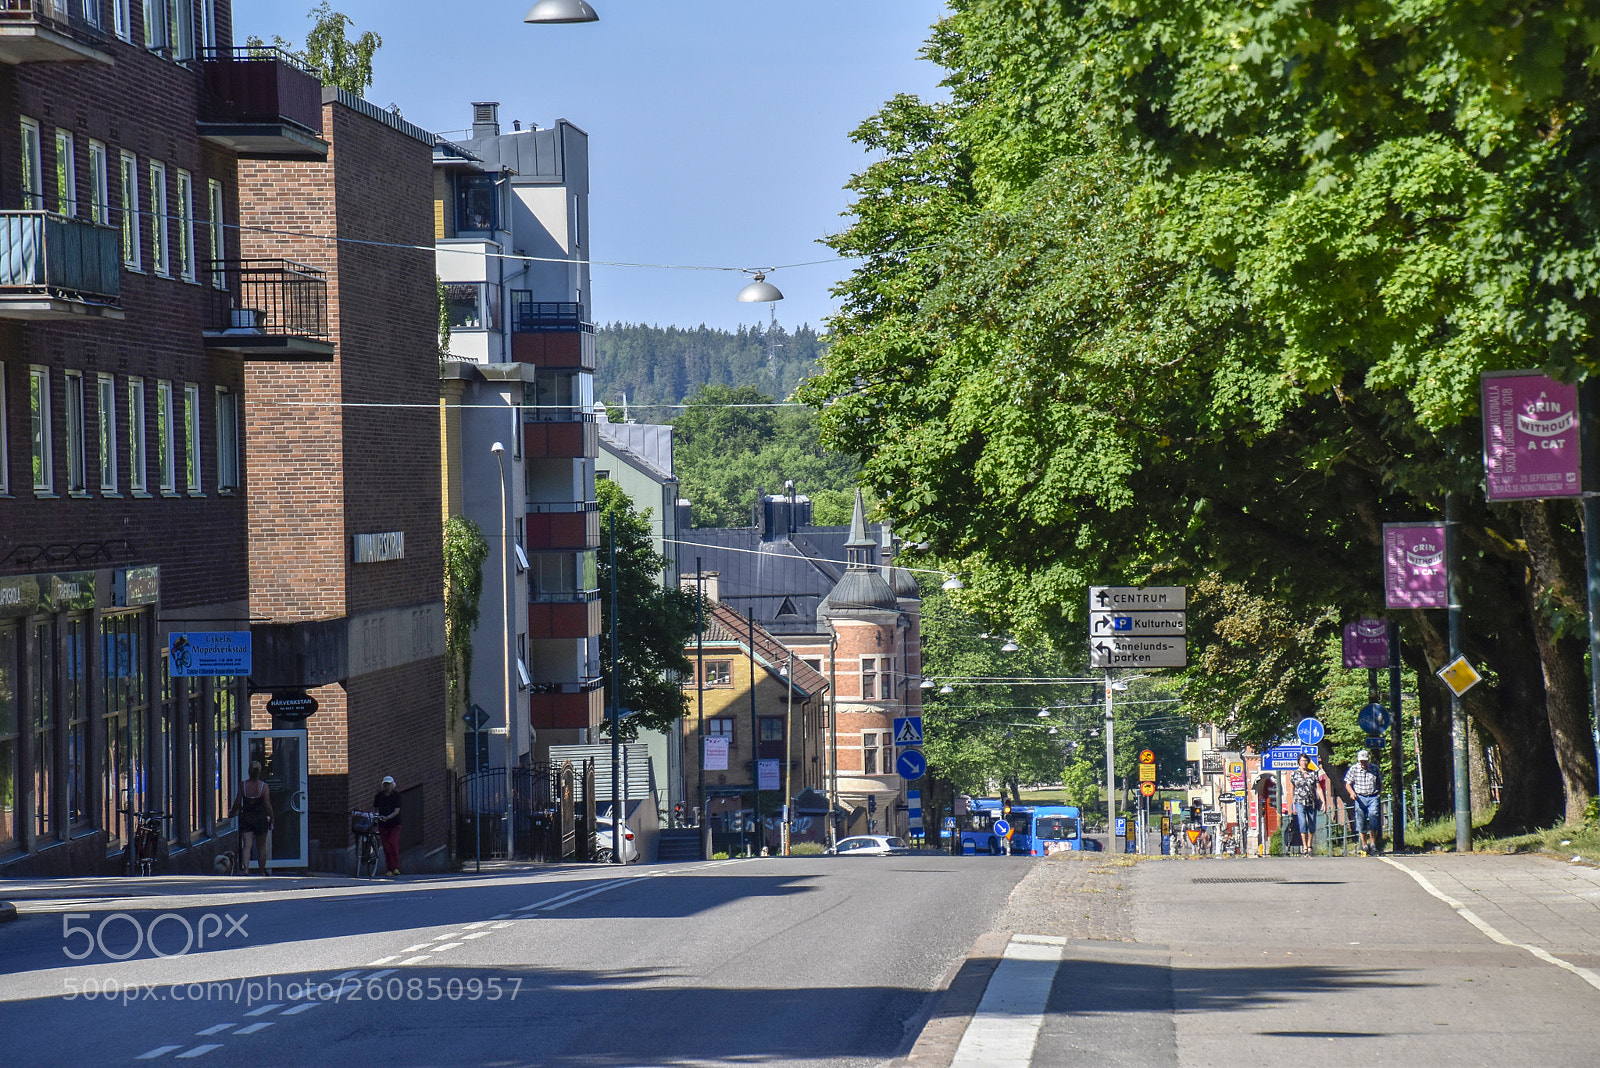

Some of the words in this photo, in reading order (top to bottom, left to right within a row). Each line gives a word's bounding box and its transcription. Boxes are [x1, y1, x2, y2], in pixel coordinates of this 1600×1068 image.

[1526, 402, 1561, 414] GRIN
[1520, 416, 1571, 432] WITHOUT
[1528, 441, 1537, 450] A
[1541, 440, 1566, 449] CAT
[1413, 544, 1436, 552] GRIN
[1114, 594, 1167, 603] CENTRUM
[1134, 619, 1183, 628] Kulturhus
[206, 634, 225, 644] Cykel
[192, 645, 247, 656] Mopedverkstad
[1114, 642, 1174, 651] Annelunds-
[1114, 653, 1151, 663] parken
